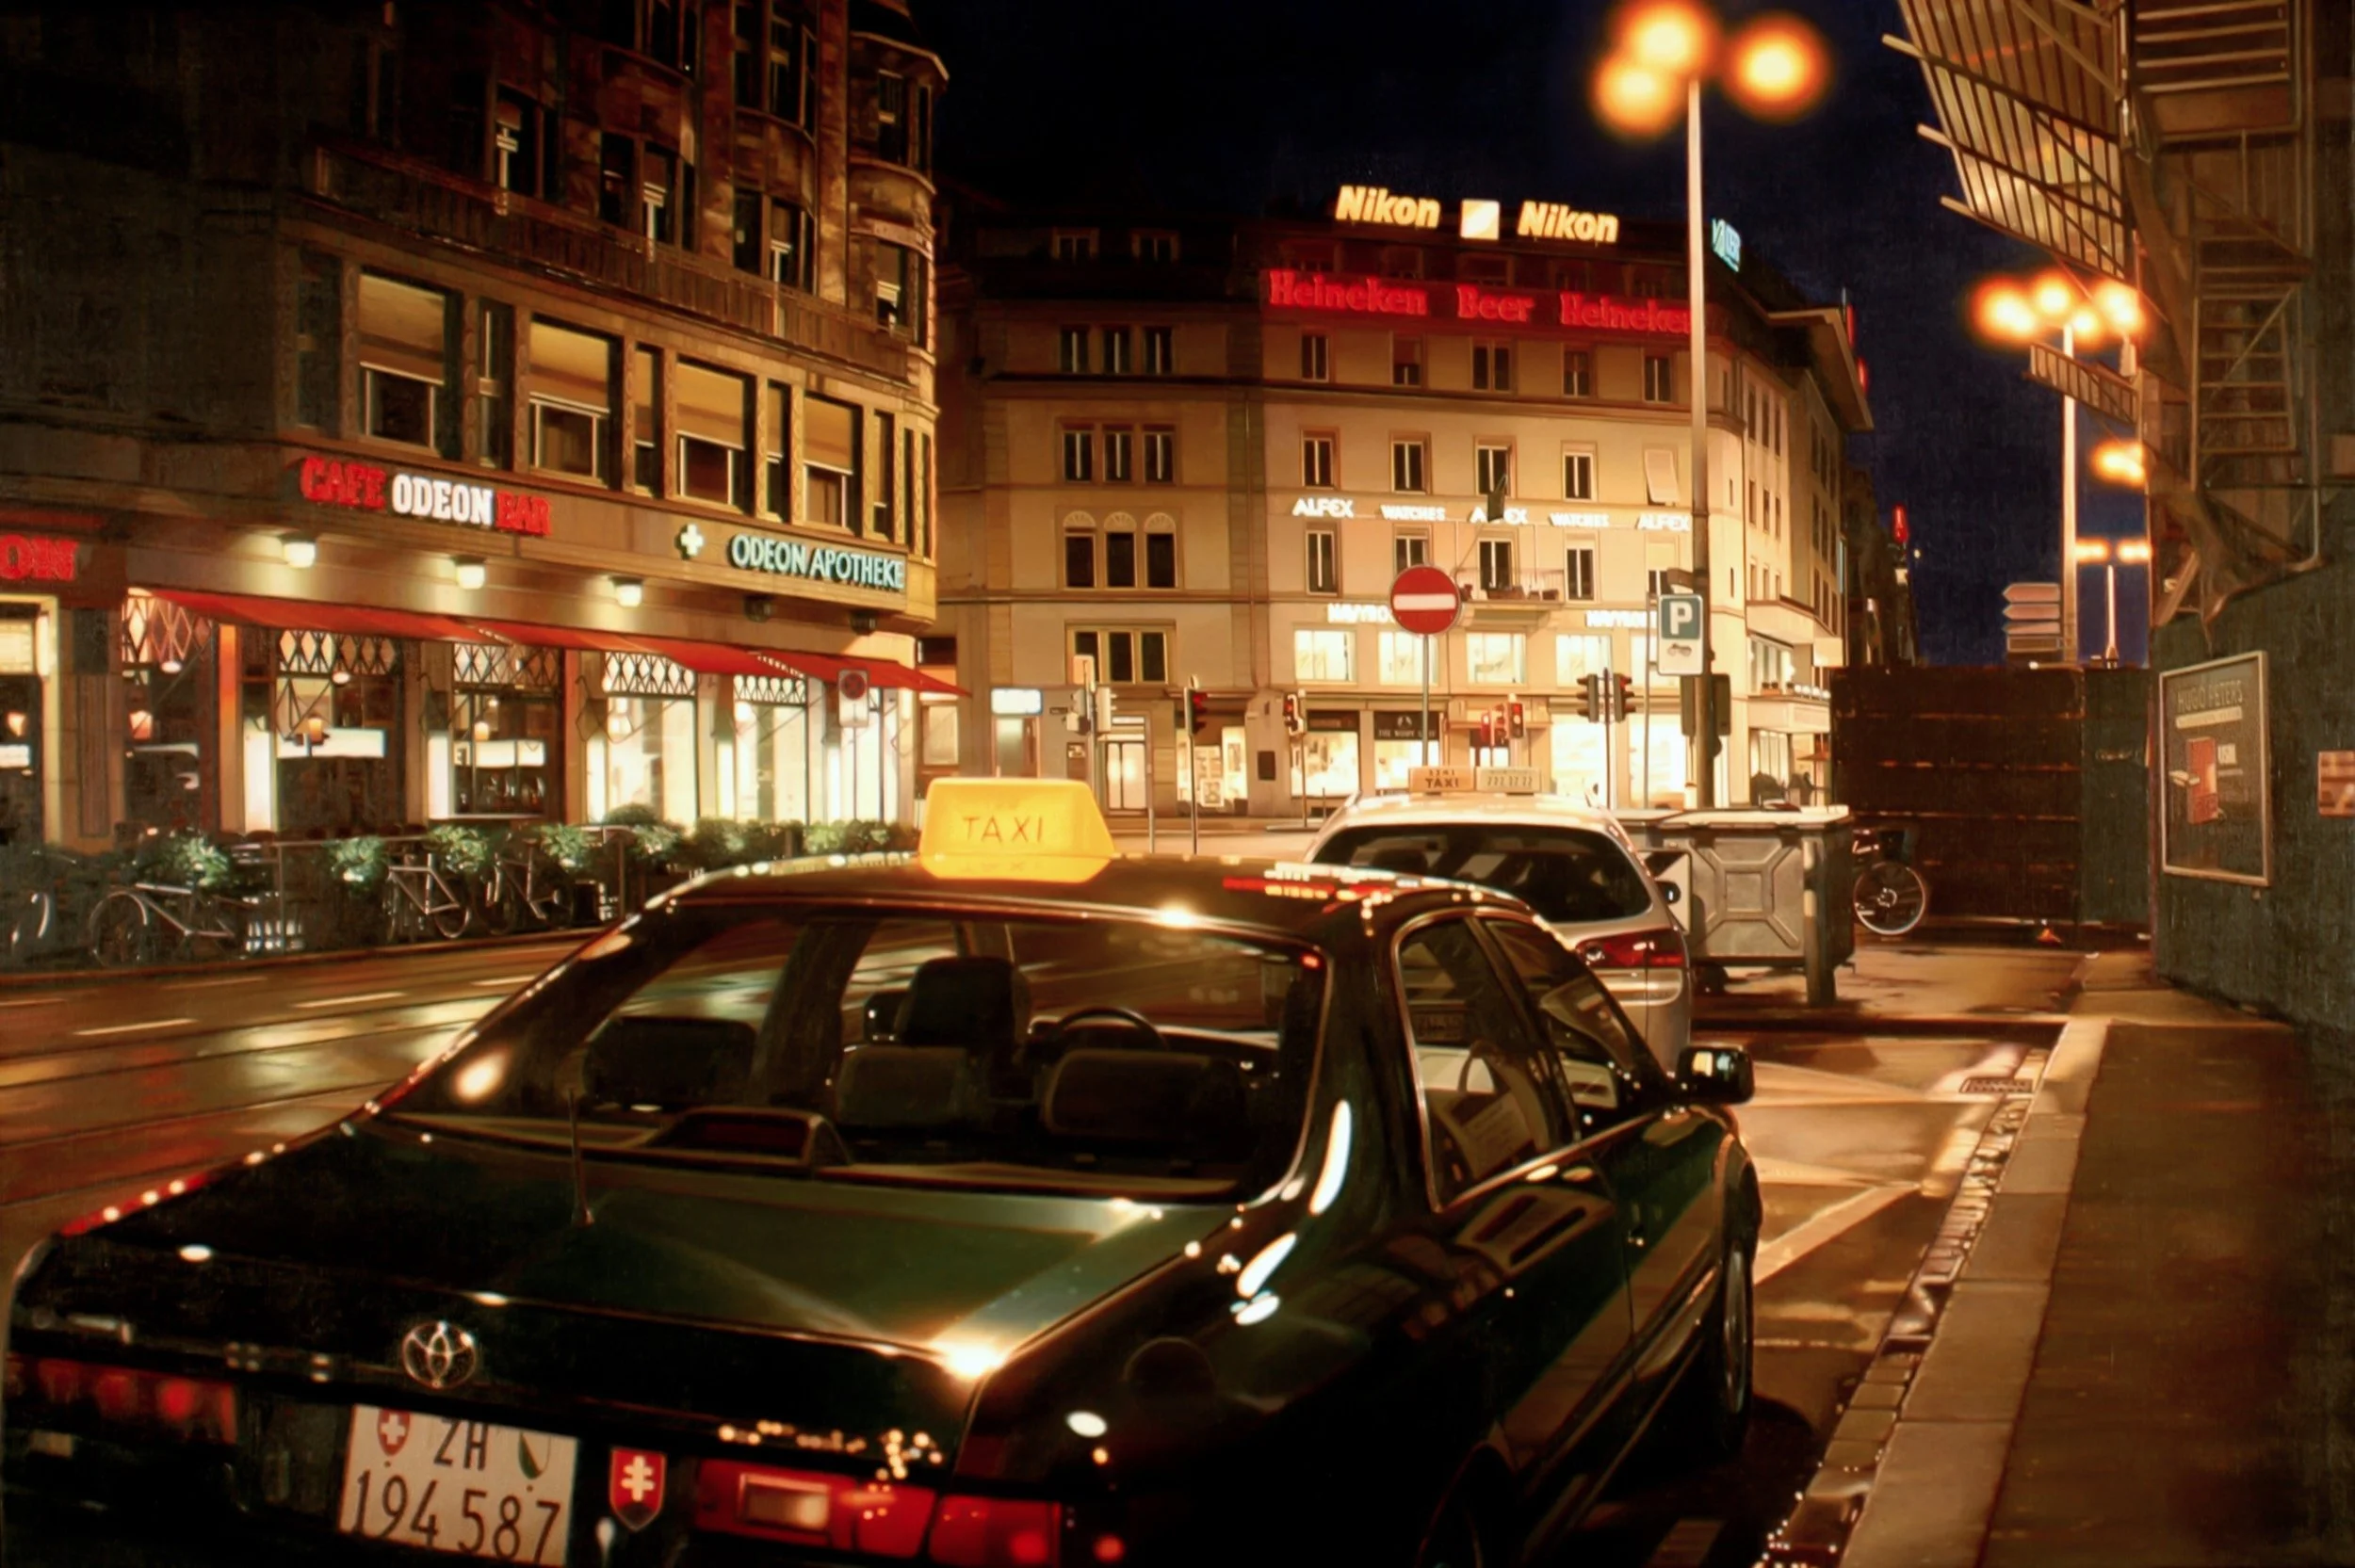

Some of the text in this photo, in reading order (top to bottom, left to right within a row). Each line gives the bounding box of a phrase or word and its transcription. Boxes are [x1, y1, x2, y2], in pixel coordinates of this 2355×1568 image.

[1335, 185, 1618, 243] Nikon Nikon
[1269, 269, 1692, 335] Heineken Beer Heineke
[300, 456, 552, 537] CAFE ODEON BAR
[1291, 496, 1355, 519] ALFEX
[1379, 504, 1447, 522] WATCHES
[1469, 506, 1529, 525] AEX
[1637, 511, 1692, 532] ALFEX
[731, 533, 906, 590] ODEON APOTHEKE
[1669, 601, 1693, 636] P
[1425, 777, 1459, 788] TAXI
[963, 815, 1043, 844] TAXI
[433, 1418, 489, 1471] ZH
